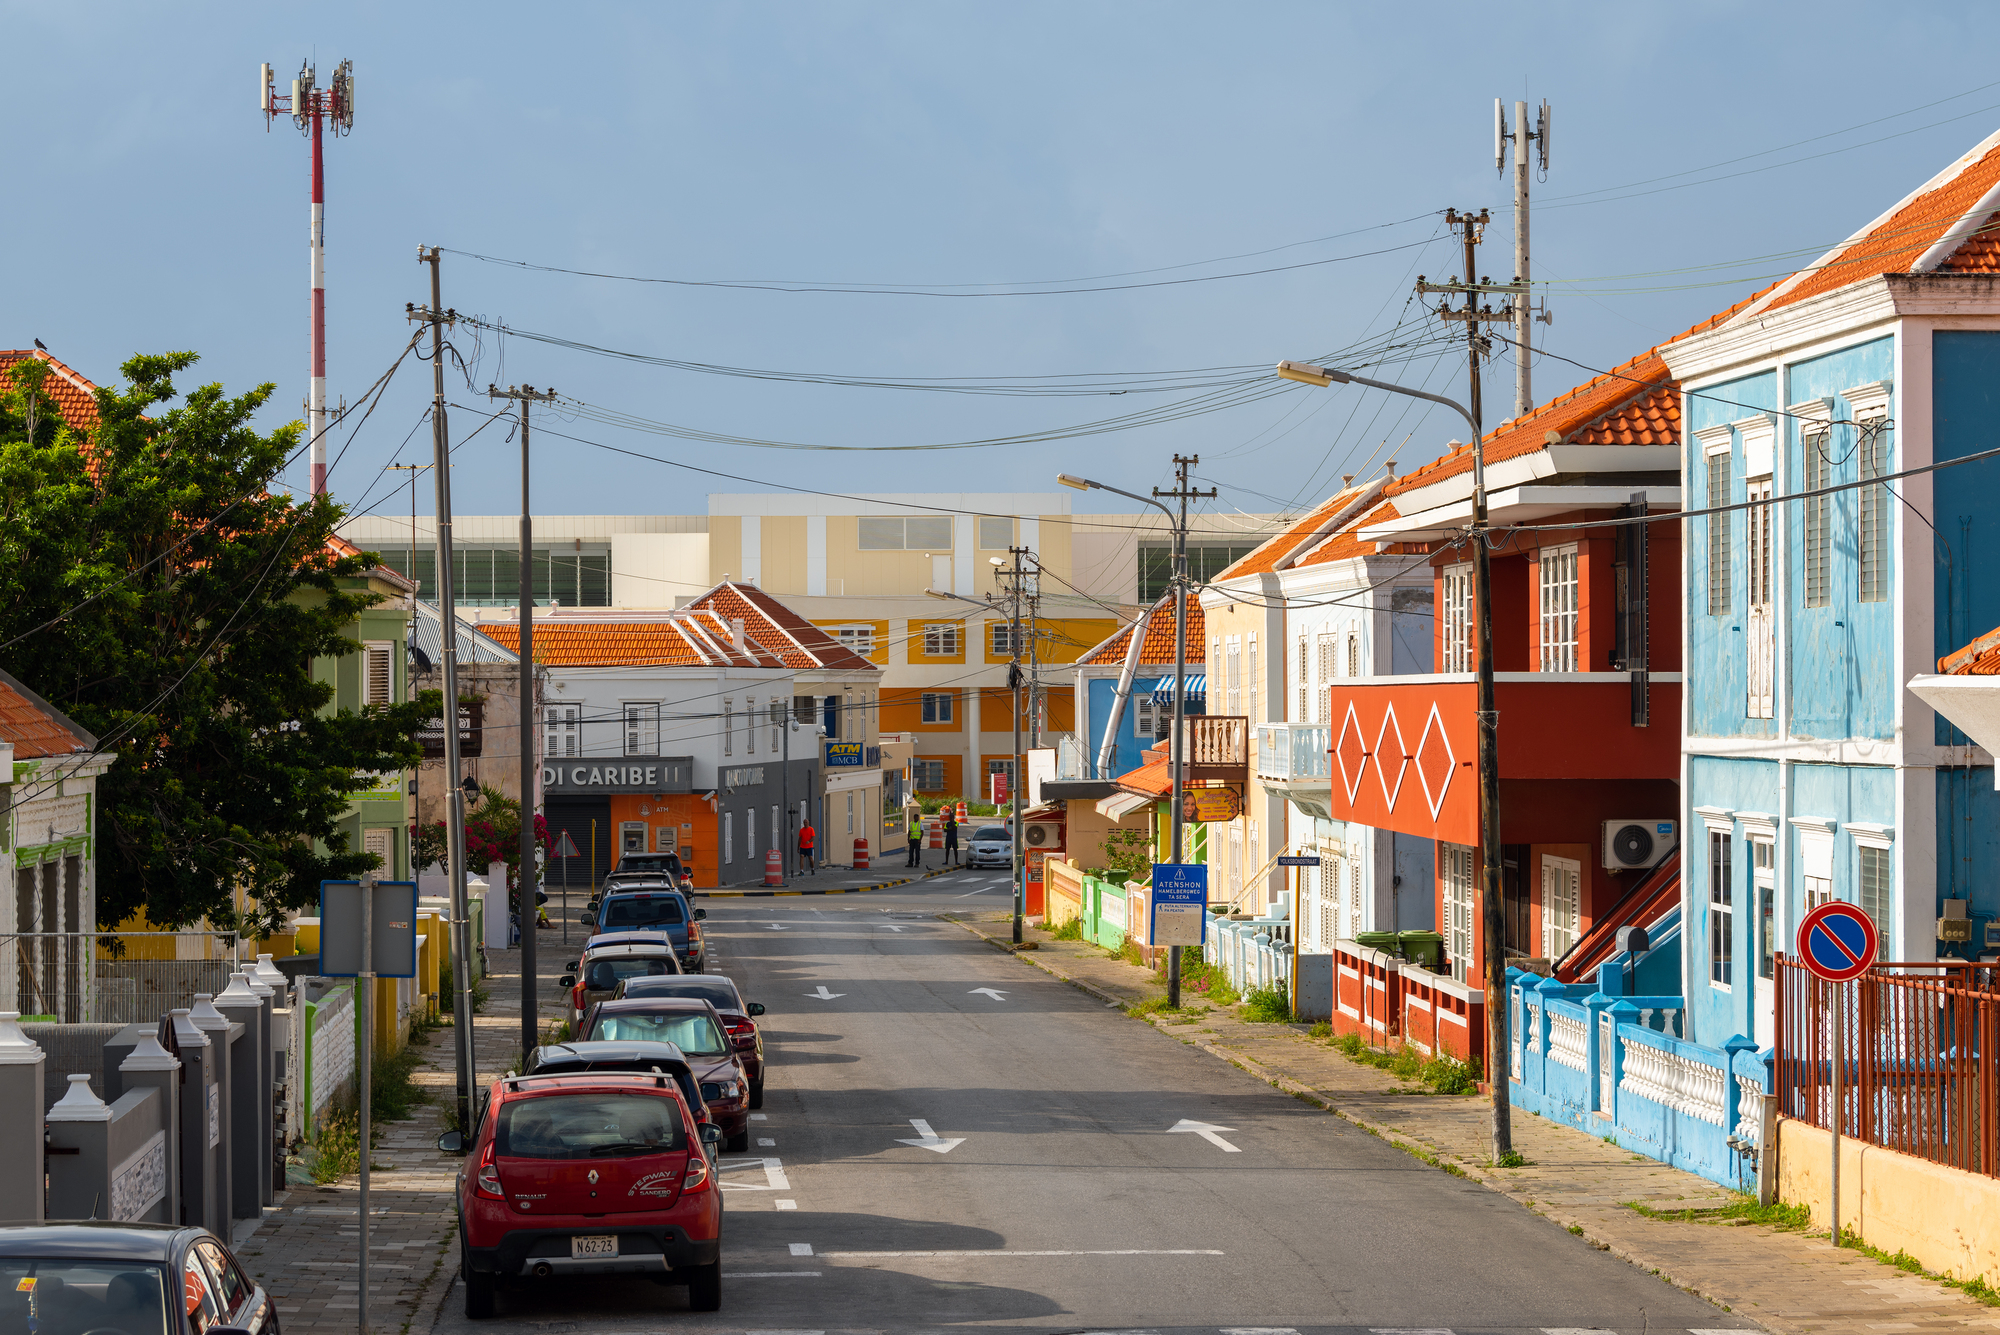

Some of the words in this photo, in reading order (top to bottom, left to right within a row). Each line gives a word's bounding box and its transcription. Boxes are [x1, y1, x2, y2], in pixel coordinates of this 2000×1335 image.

[828, 744, 861, 753] ATM
[838, 756, 858, 764] MCB
[571, 766, 657, 786] CARIBE
[627, 1170, 671, 1197] STEPWAY
